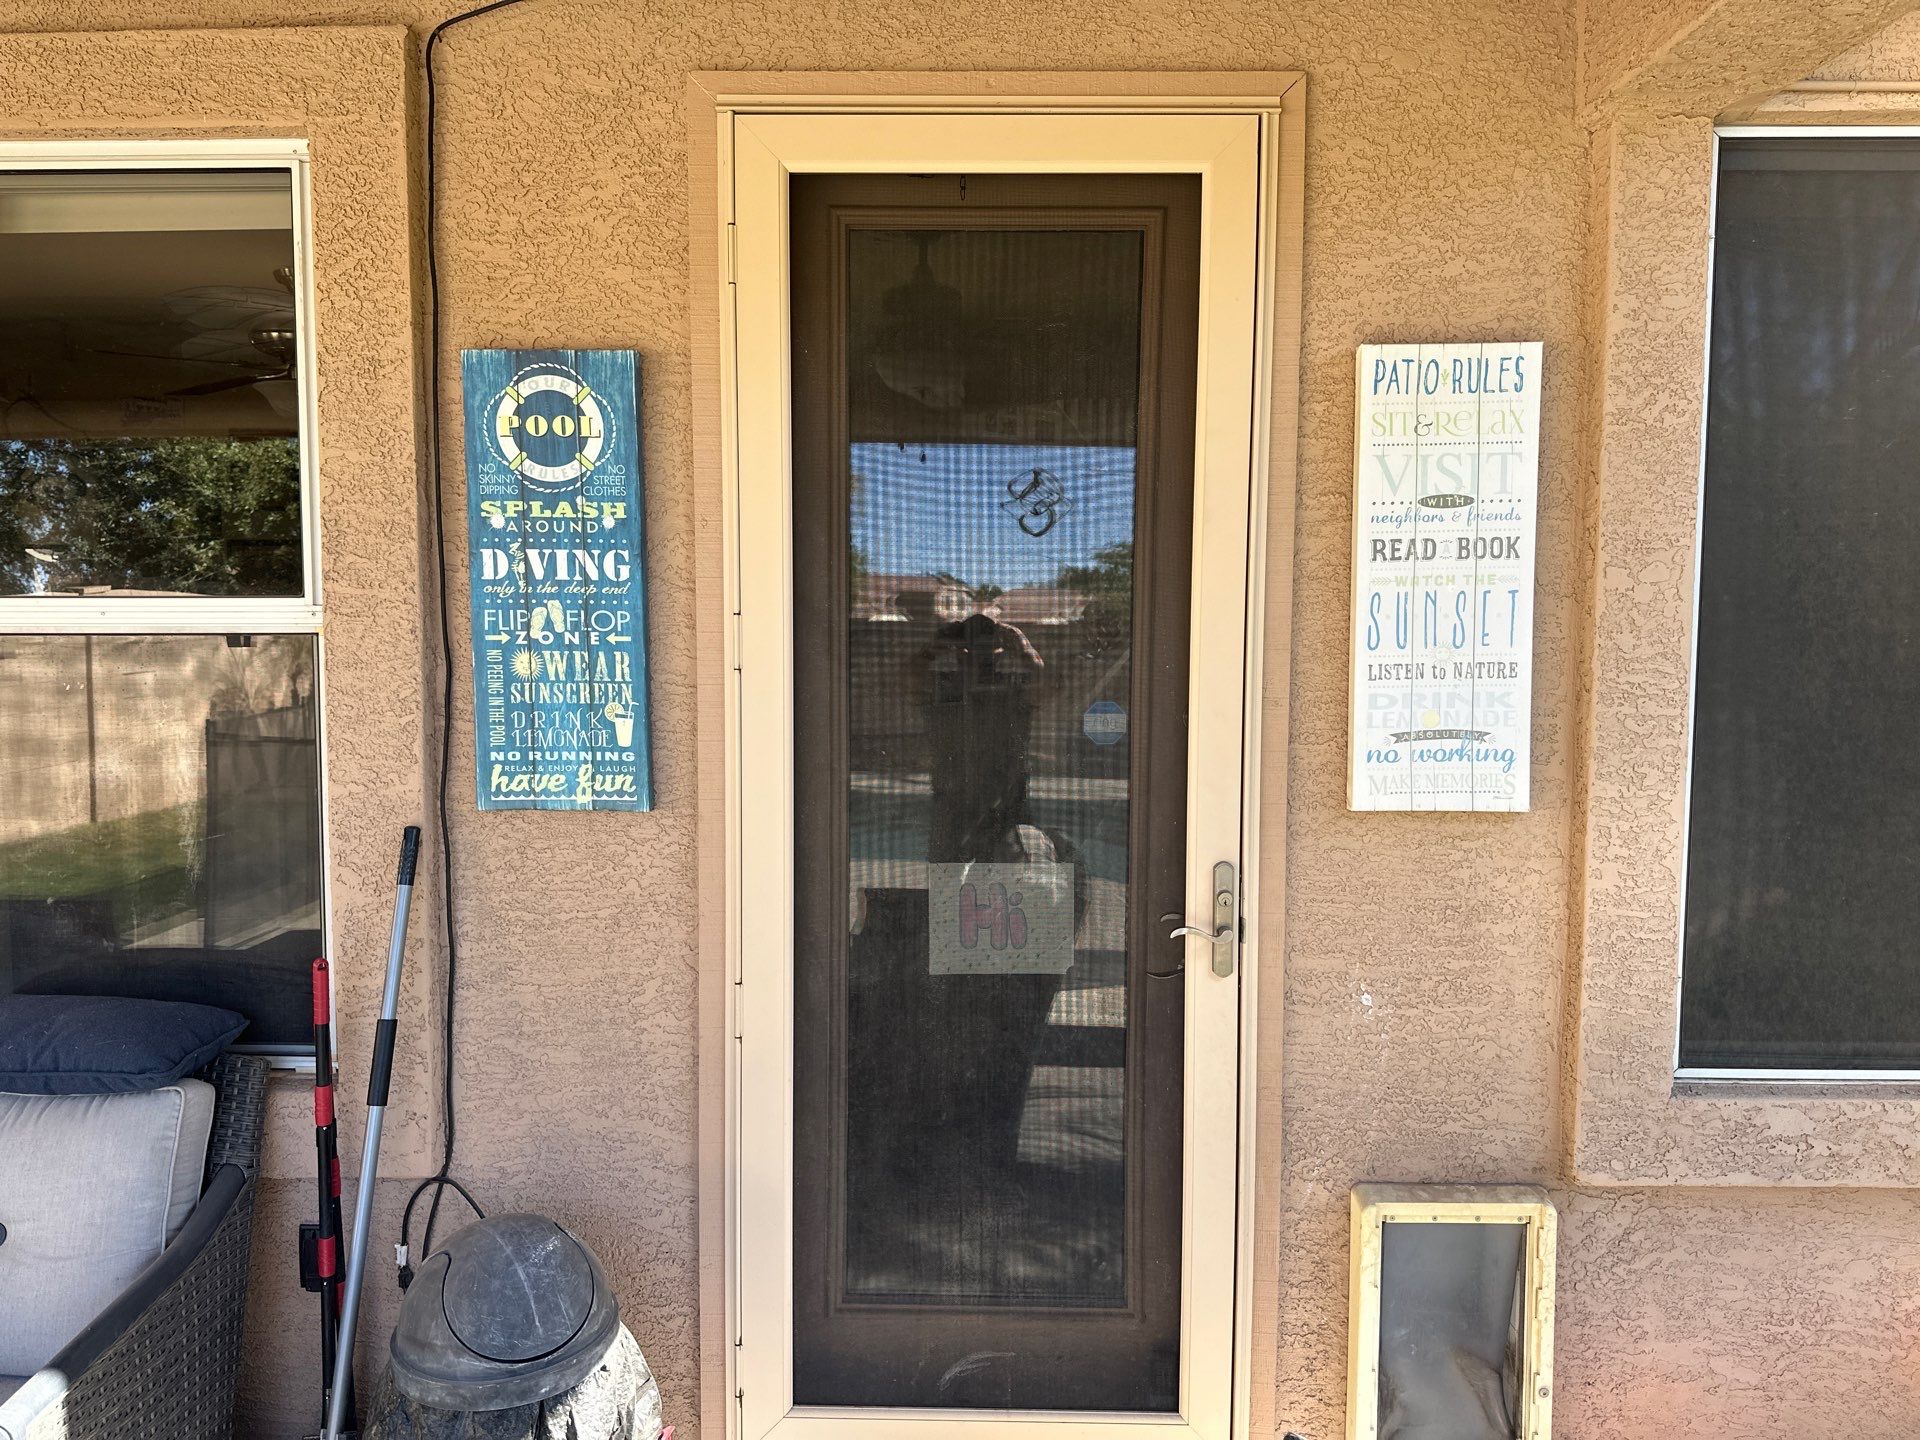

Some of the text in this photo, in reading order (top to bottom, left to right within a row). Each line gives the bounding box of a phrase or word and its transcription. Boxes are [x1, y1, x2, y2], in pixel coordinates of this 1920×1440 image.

[528, 376, 571, 391] OUR
[1373, 355, 1525, 395] PATIO RULES
[499, 414, 601, 438] POOL
[1371, 411, 1413, 437] SIT
[1413, 413, 1433, 437] &
[478, 463, 496, 473] NO
[525, 464, 580, 480] RULES
[607, 464, 626, 474] NO
[1372, 452, 1523, 497] VISIT
[479, 474, 517, 484] SKINNY
[593, 475, 626, 485] STREET
[480, 485, 519, 495] DIPPING
[583, 486, 627, 496] CLOTHES
[480, 500, 627, 519] SPLASH
[1427, 495, 1465, 506] WITH
[506, 520, 599, 533] AROUND
[1370, 505, 1522, 529] neighbors & friends
[1370, 538, 1437, 563] READ
[1457, 536, 1521, 560] BOOK
[483, 580, 516, 598] only
[536, 581, 560, 594] the
[564, 582, 597, 597] deep
[602, 581, 631, 595] end
[1394, 573, 1498, 587] WATCH THE
[484, 609, 631, 632] FLIP FLOP
[1367, 589, 1520, 651] SUNSET
[516, 631, 601, 645] ZONE
[542, 650, 632, 682] WEAR
[1367, 661, 1519, 681] LISTEN to NATURE
[487, 649, 506, 747] NO PEEING IN THE POOL
[511, 683, 634, 705] SUNSCREEN
[1367, 691, 1515, 710] DRINK
[511, 708, 604, 729] DRINK
[511, 727, 614, 748] LEMONADE
[1402, 729, 1480, 741] ABSOLUTELY
[490, 751, 636, 762] NO RUNNING
[1366, 739, 1517, 773] no working
[599, 765, 637, 773] LAUGH
[490, 763, 637, 804] have fun
[1368, 773, 1516, 797] MAKE MEMORIES
[959, 881, 1028, 951] Hi
